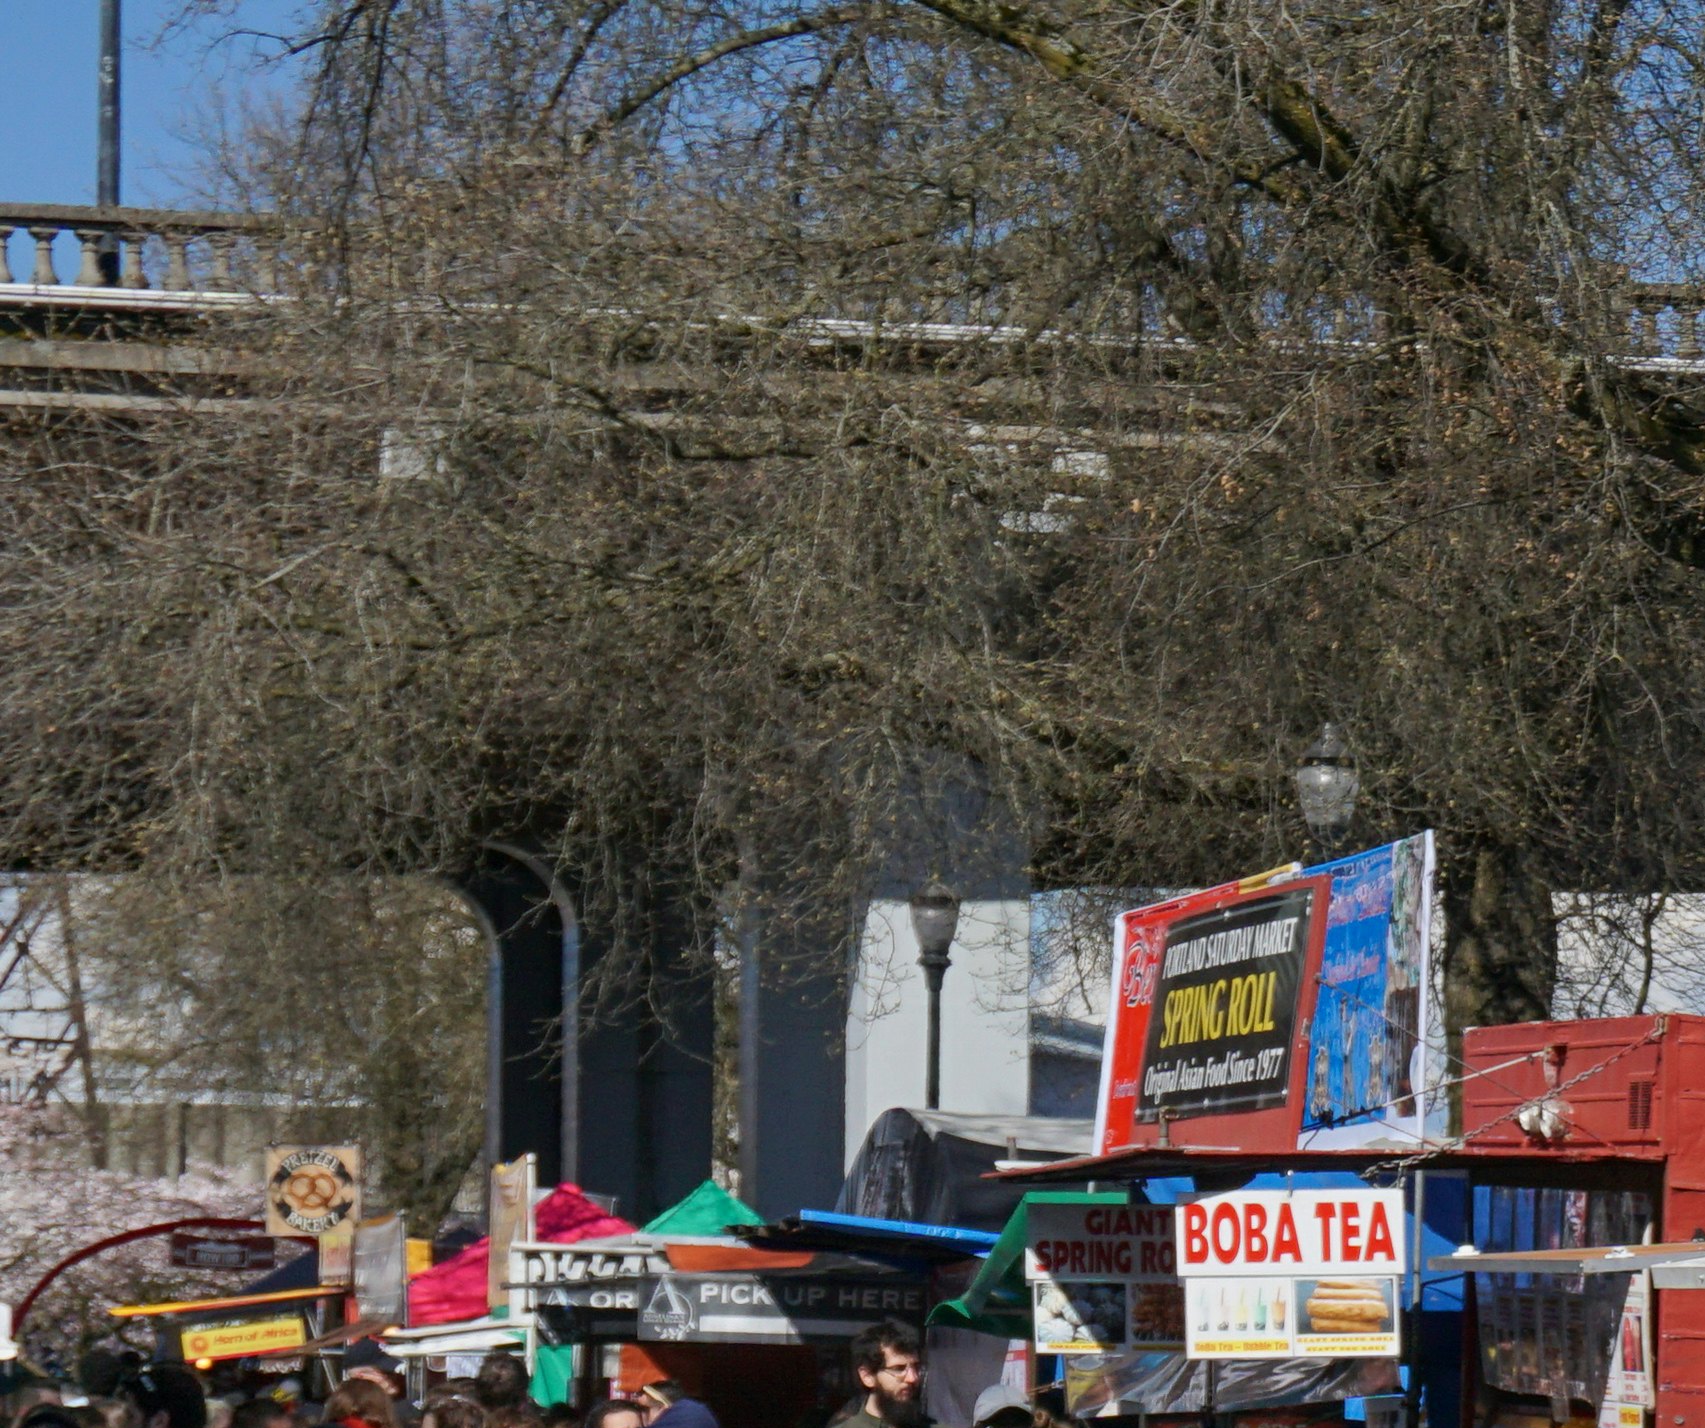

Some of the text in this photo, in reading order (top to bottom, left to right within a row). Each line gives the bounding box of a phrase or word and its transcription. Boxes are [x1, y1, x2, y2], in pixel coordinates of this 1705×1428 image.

[1162, 937, 1207, 980] PORTLAND
[1205, 925, 1254, 969] SATURDAY
[1252, 917, 1299, 959] MARKET
[1160, 971, 1277, 1048] SPRING ROLL
[1144, 1059, 1180, 1105] Original
[1178, 1057, 1204, 1091] Asian
[1204, 1051, 1229, 1087] Food
[1228, 1050, 1255, 1085] Since
[1256, 1047, 1284, 1081] 1977
[281, 1149, 340, 1172] PRETZEL
[286, 1212, 338, 1233] BAKERY
[1085, 1209, 1170, 1236] GIANT
[1184, 1201, 1396, 1265] BOBA TEA
[1034, 1240, 1133, 1274] SPRING
[700, 1284, 921, 1309] PICK UP HERE
